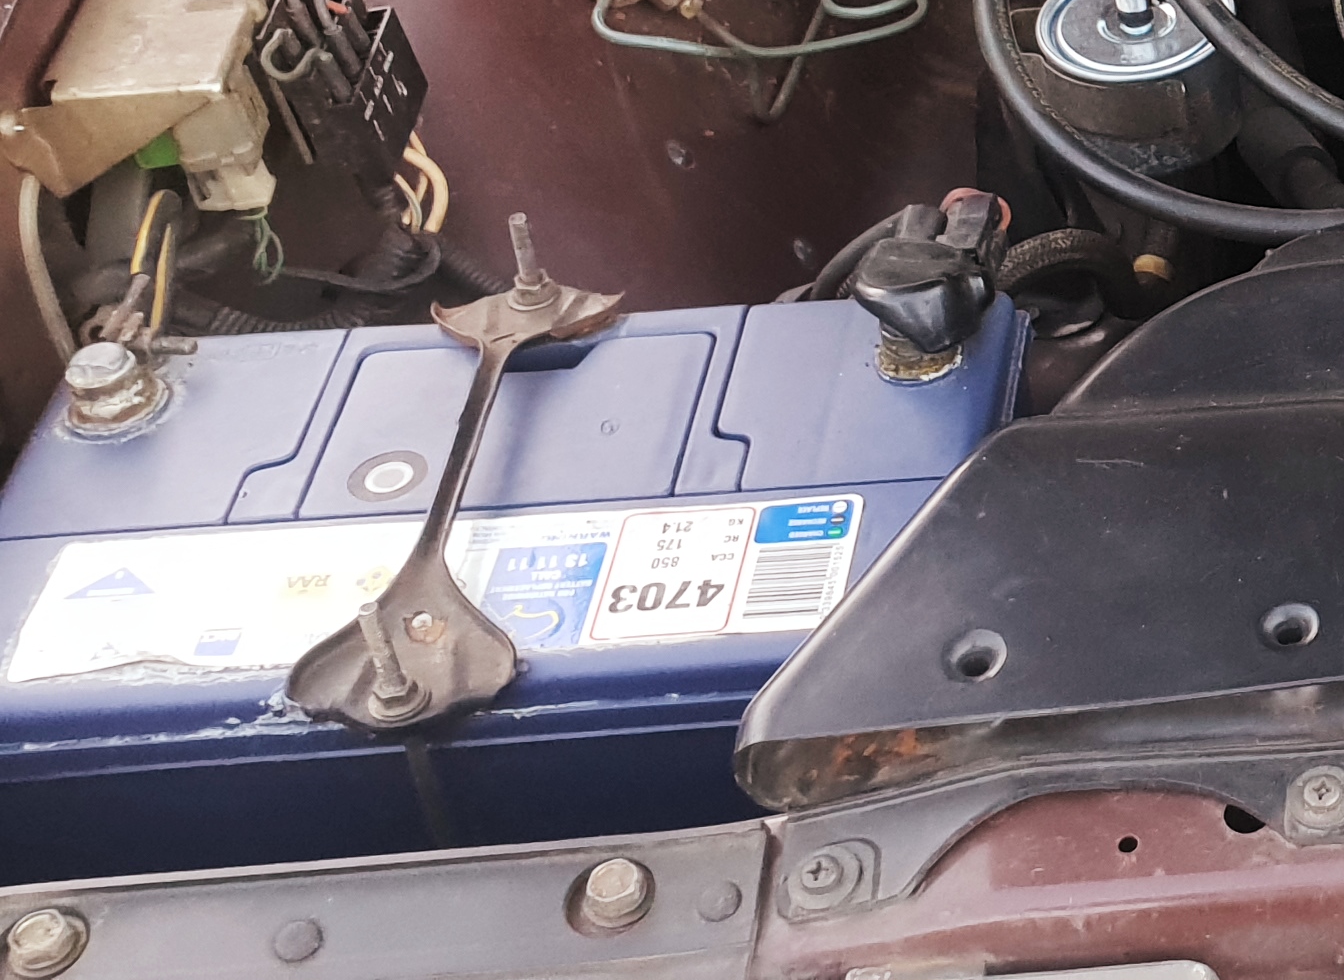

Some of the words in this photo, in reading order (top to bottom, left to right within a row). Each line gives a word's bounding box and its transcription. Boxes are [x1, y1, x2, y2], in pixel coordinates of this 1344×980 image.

[662, 520, 692, 534] 21.4
[728, 517, 744, 526] KG
[657, 538, 682, 551] 175
[723, 534, 740, 543] RC
[507, 556, 529, 571] 11
[536, 554, 558, 569] 11
[564, 553, 588, 568] 13
[651, 556, 680, 570] 850
[711, 553, 735, 562] CCA
[531, 570, 562, 581] CALL
[609, 579, 725, 613] 4703
